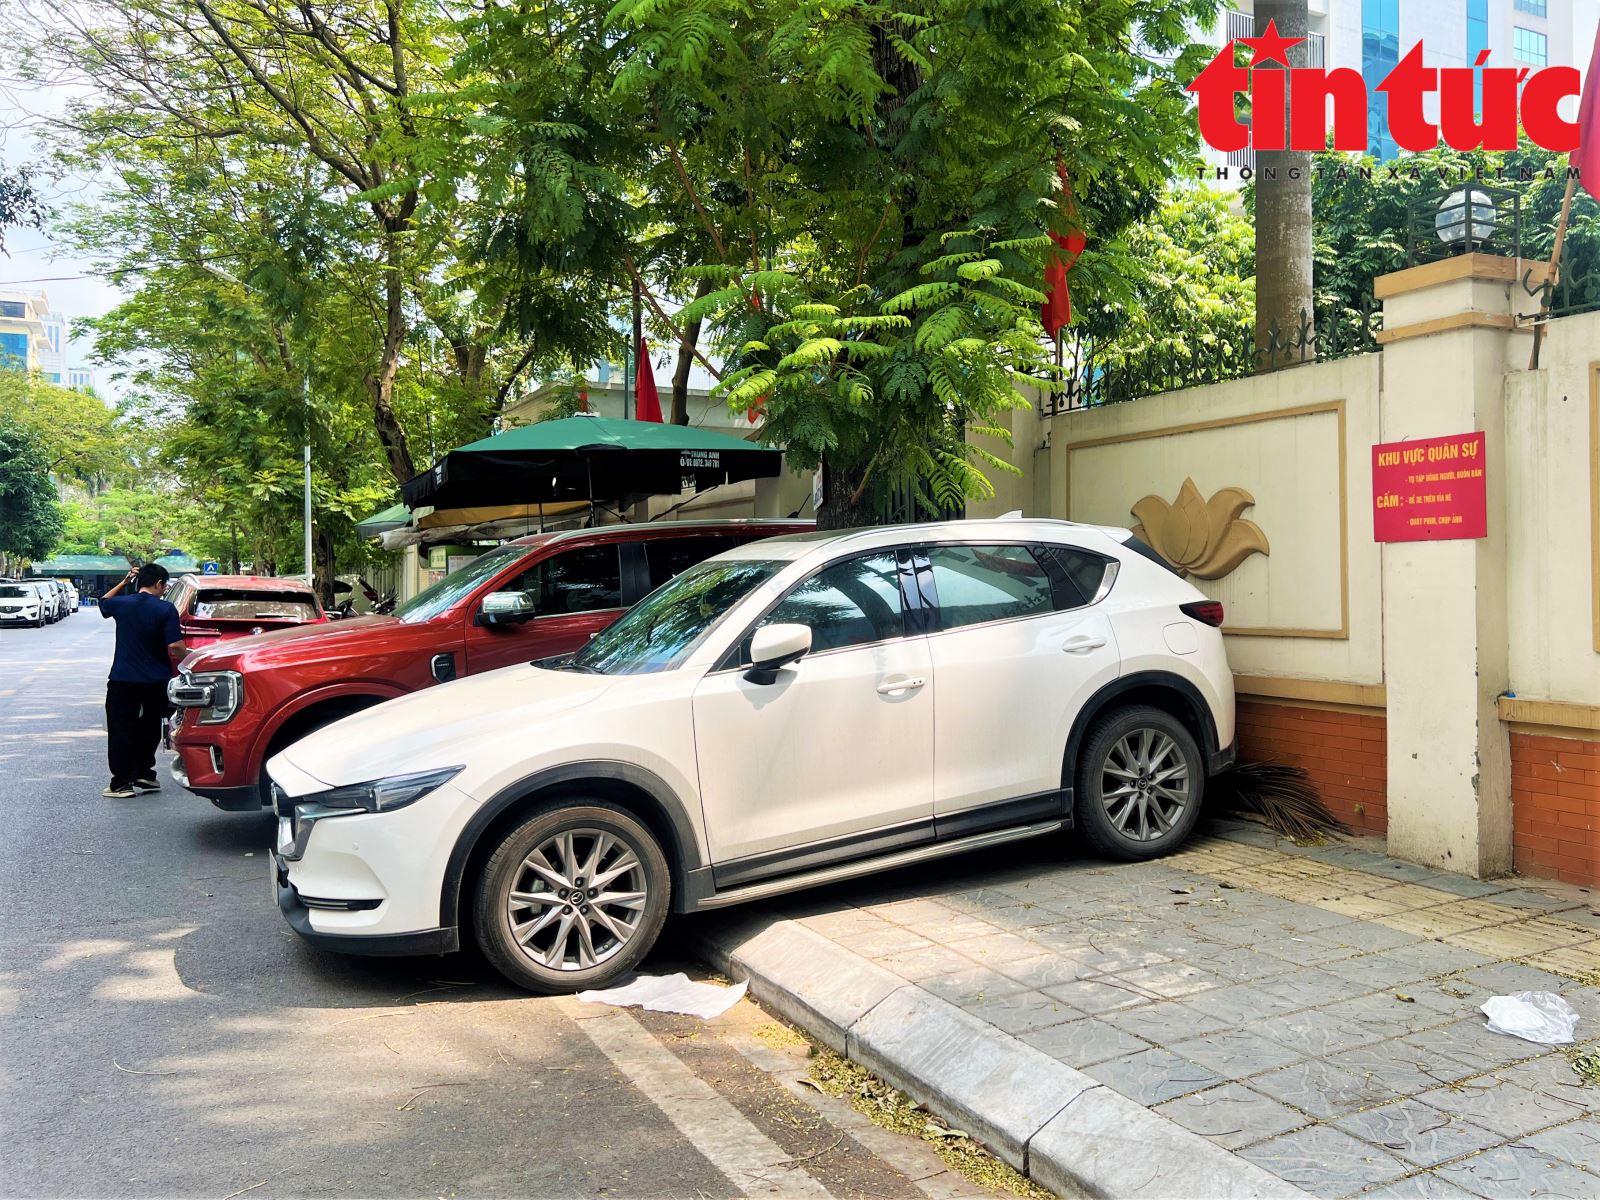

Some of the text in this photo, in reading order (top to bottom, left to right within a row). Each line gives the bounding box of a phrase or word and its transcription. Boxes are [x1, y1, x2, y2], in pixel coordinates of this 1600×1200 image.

[1378, 440, 1479, 467] KHU VỰC QUÂN SỰ
